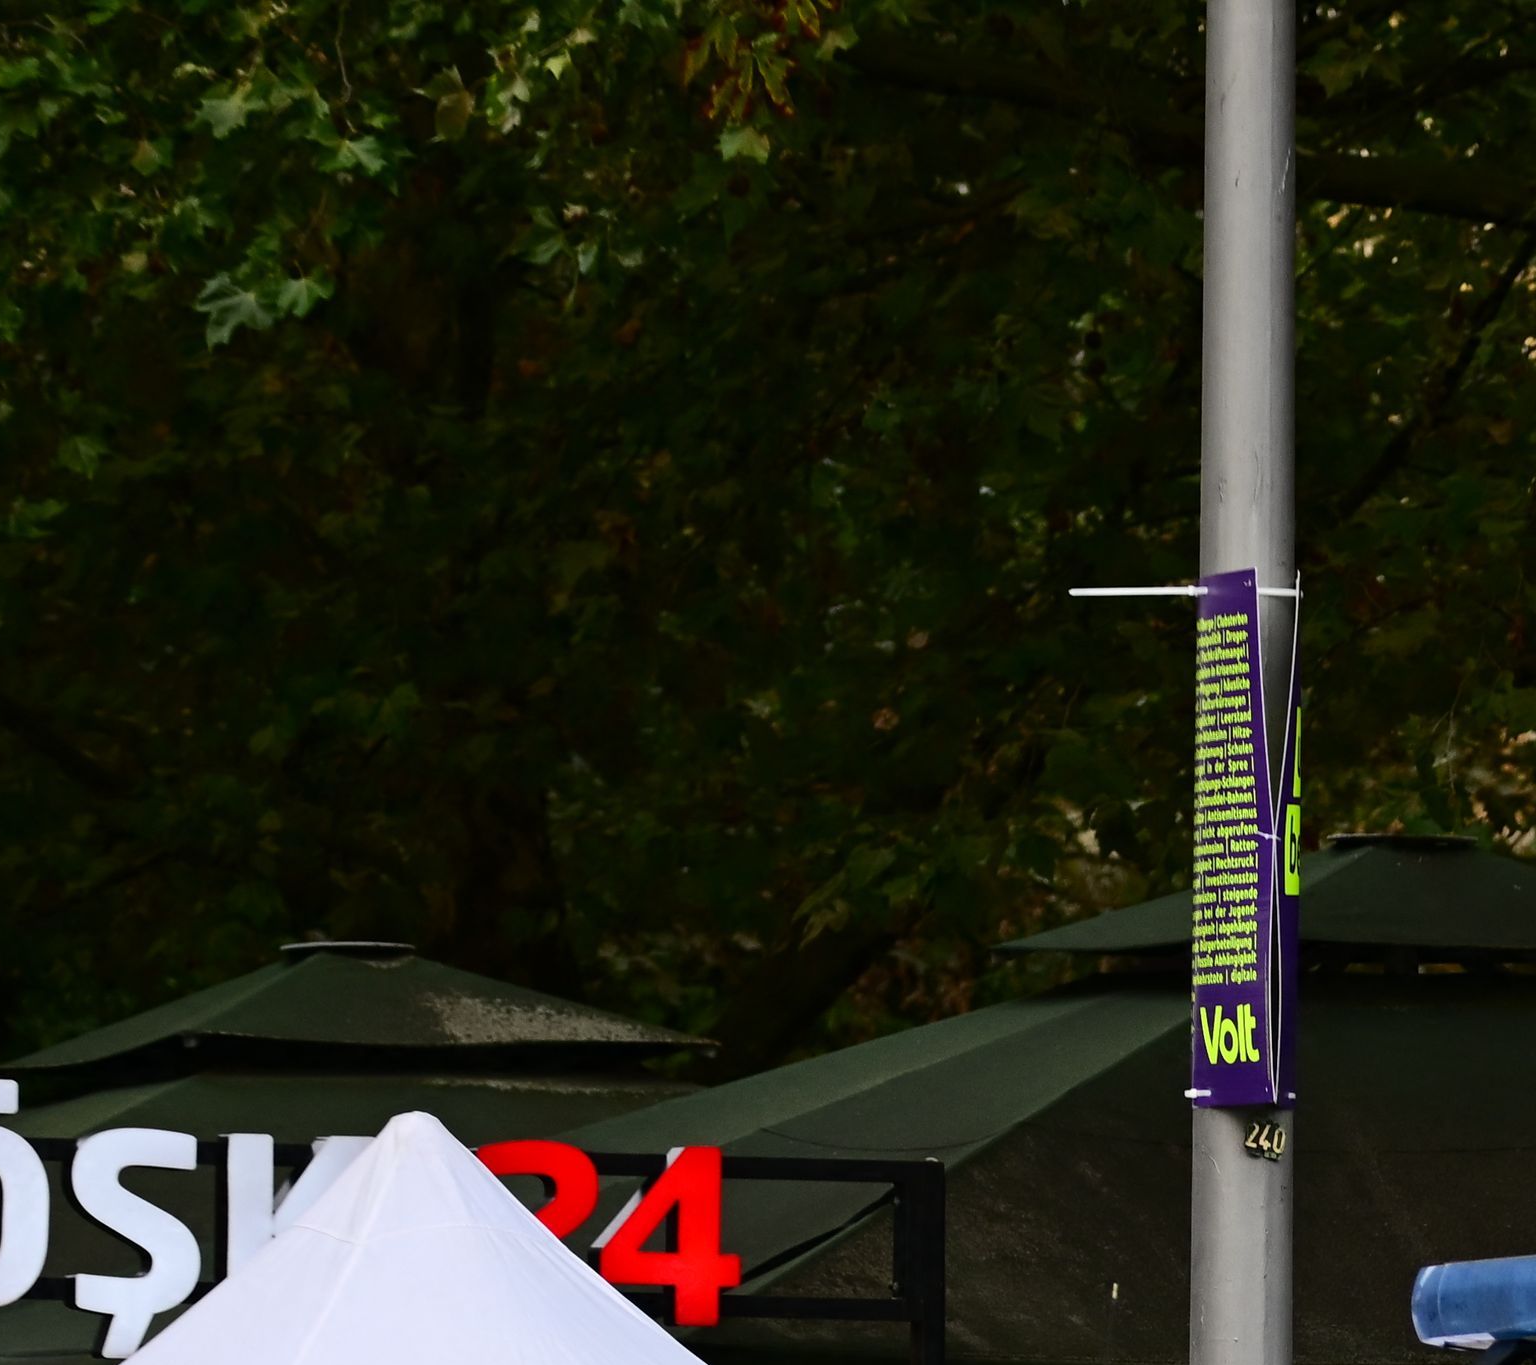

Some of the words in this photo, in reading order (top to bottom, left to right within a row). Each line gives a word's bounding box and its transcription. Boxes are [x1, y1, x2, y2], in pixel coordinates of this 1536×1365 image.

[1221, 710, 1252, 725] Leerstand
[1233, 725, 1253, 739] Hitze-
[1228, 740, 1254, 756] Schulen
[1215, 759, 1225, 774] der
[1228, 758, 1248, 776] Spree
[1207, 806, 1258, 821] Antisemitismus
[1217, 821, 1258, 840] abgerufene
[1230, 839, 1259, 852] Ratten-
[1216, 853, 1254, 870] Rechtsruck
[1205, 871, 1258, 887] Investitionsstau
[1223, 885, 1258, 903] steigende
[1204, 905, 1213, 919] bei
[1215, 904, 1226, 919] der
[1228, 901, 1257, 920] Jugend-
[1219, 919, 1257, 936] abgehängte
[1215, 950, 1257, 968] Abhängigkeit
[1230, 966, 1257, 985] digitale
[1200, 1003, 1260, 1065] Volt
[1245, 1122, 1286, 1154] 240
[477, 1139, 741, 1327] 24
